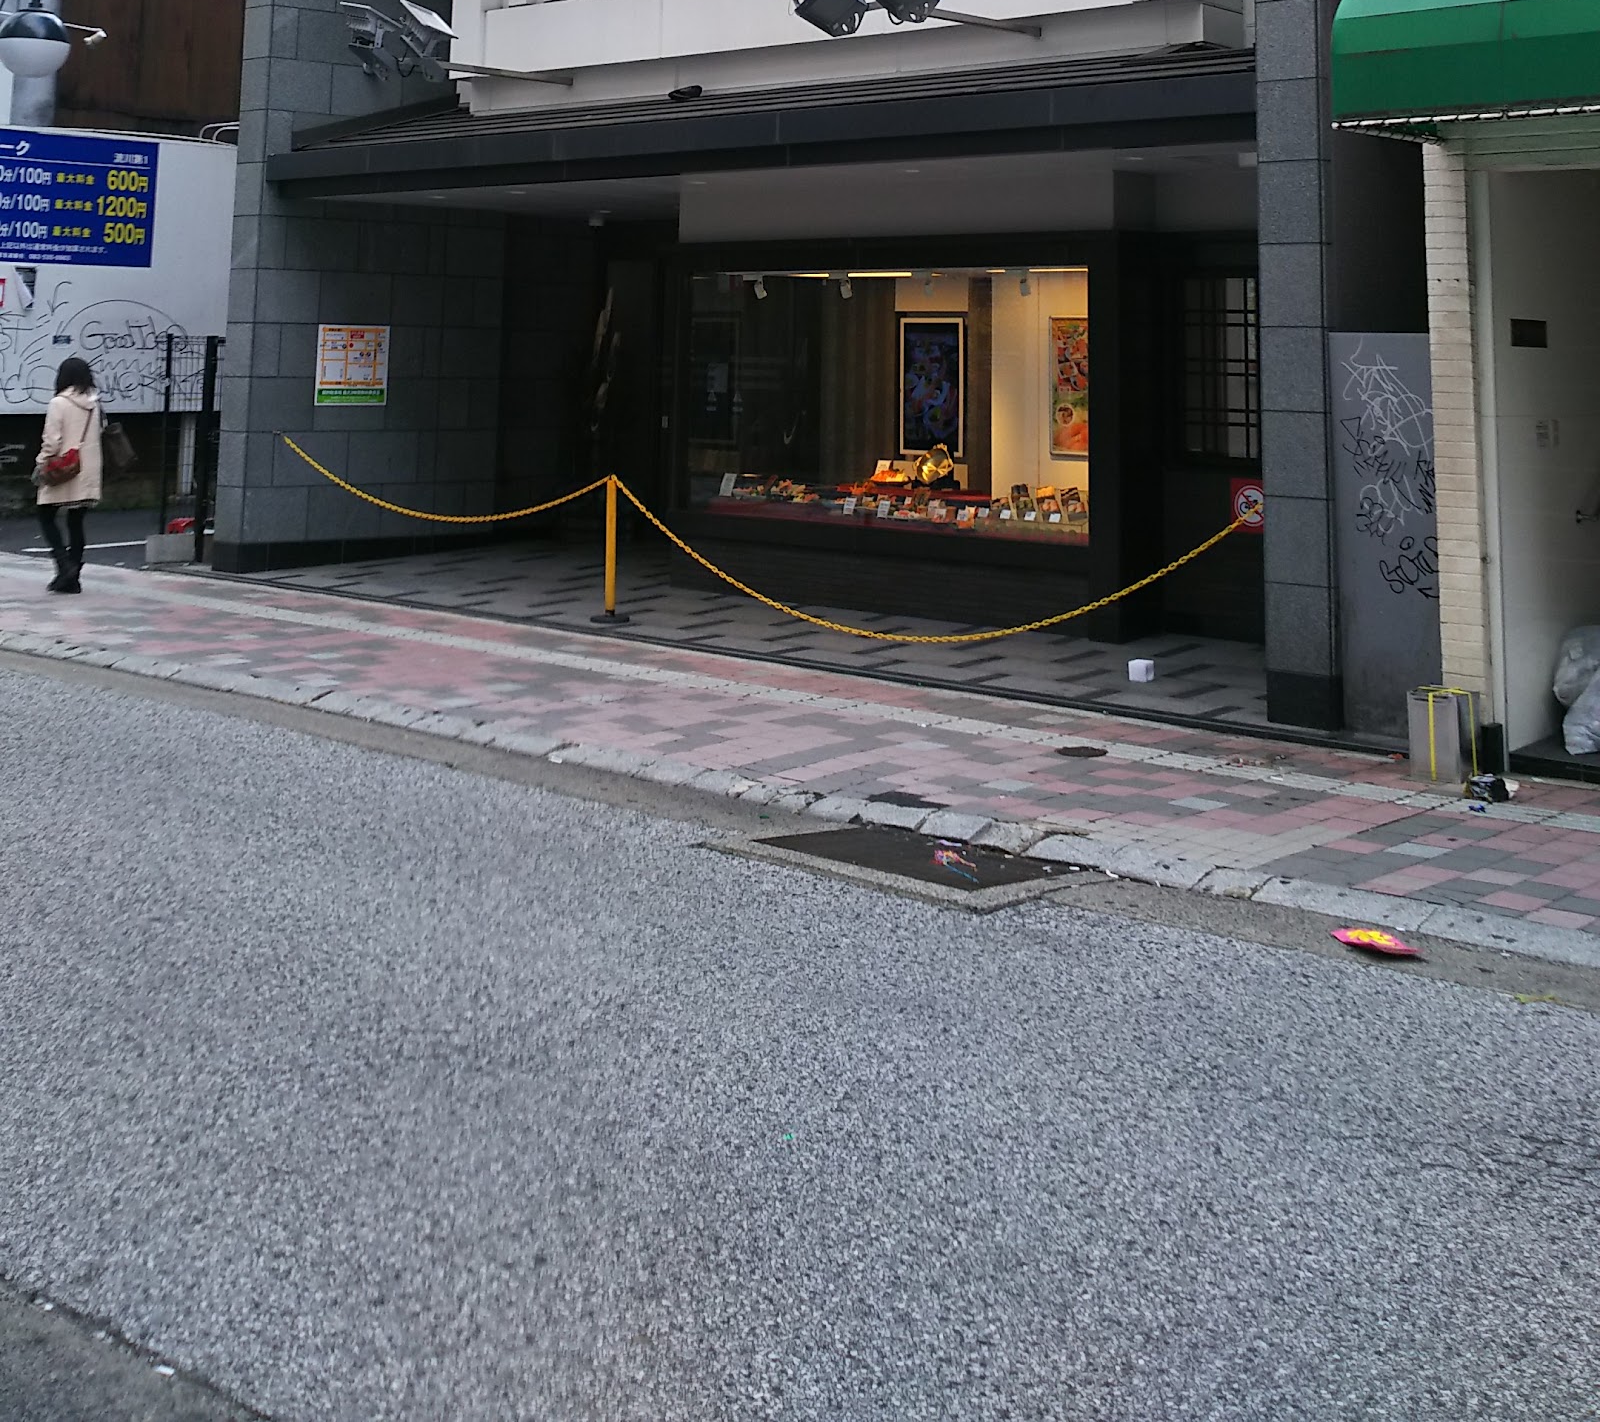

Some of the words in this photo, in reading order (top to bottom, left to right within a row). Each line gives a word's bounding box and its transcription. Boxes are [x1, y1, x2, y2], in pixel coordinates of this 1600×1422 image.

[106, 169, 149, 193] 600円
[0, 192, 51, 213] 分/100円
[96, 195, 148, 219] 1200円
[102, 222, 146, 246] 500円
